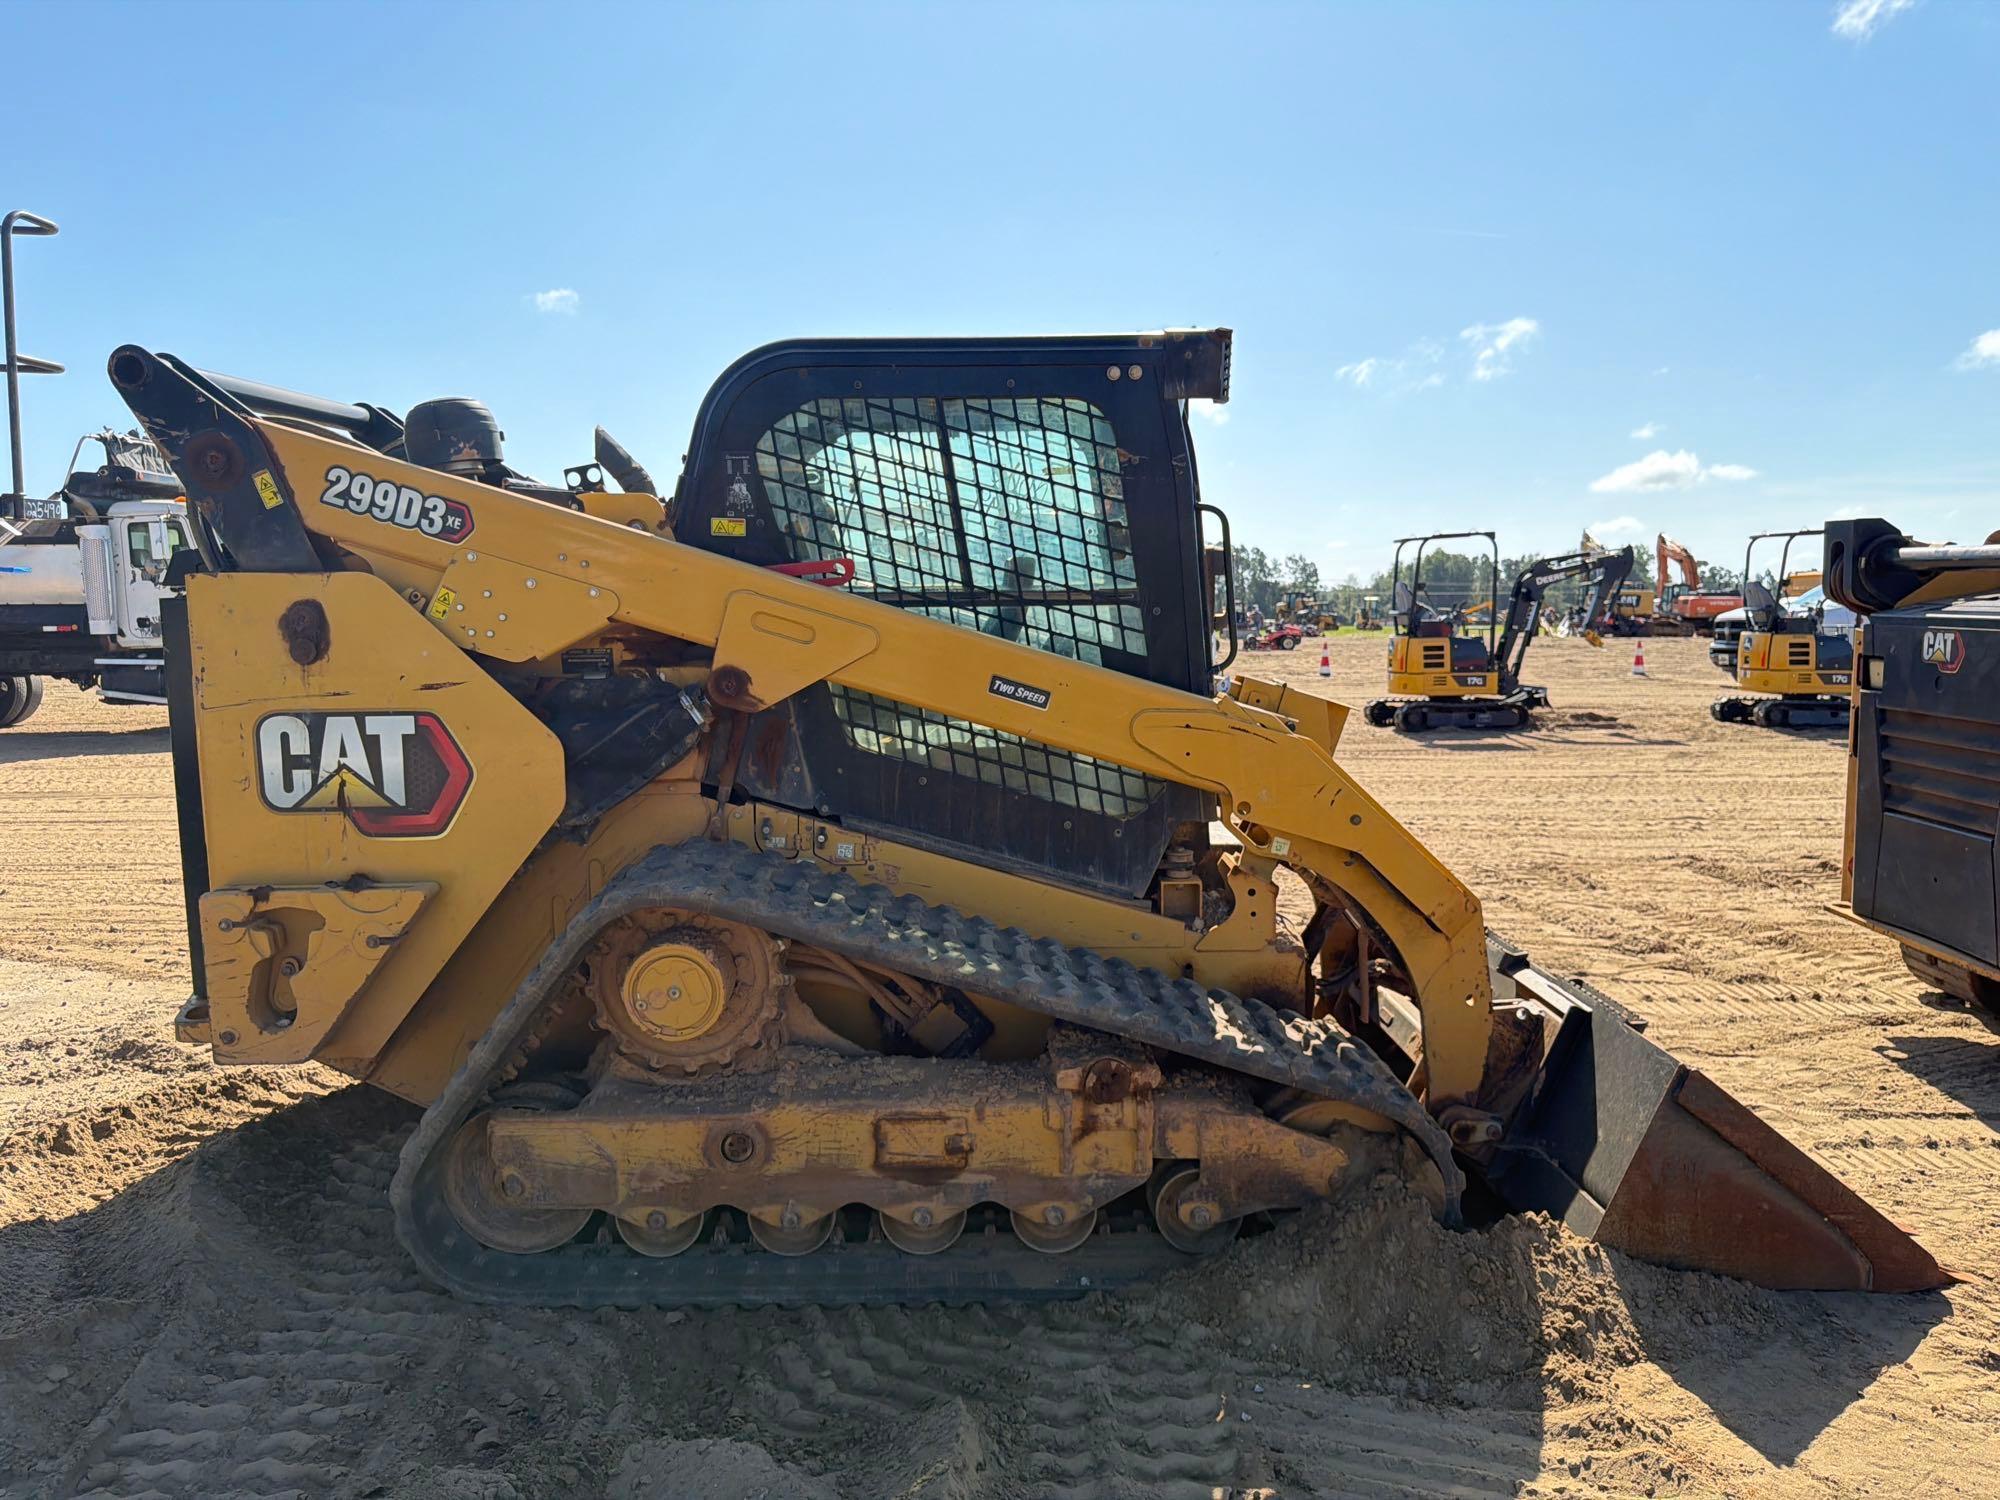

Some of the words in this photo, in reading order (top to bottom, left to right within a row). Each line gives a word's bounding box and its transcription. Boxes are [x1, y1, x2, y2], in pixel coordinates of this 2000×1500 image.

[323, 467, 447, 535] 299D3
[445, 515, 462, 530] XE
[1923, 631, 1955, 662] CAT
[1831, 674, 1848, 684] 17G
[259, 715, 416, 808] CAT
